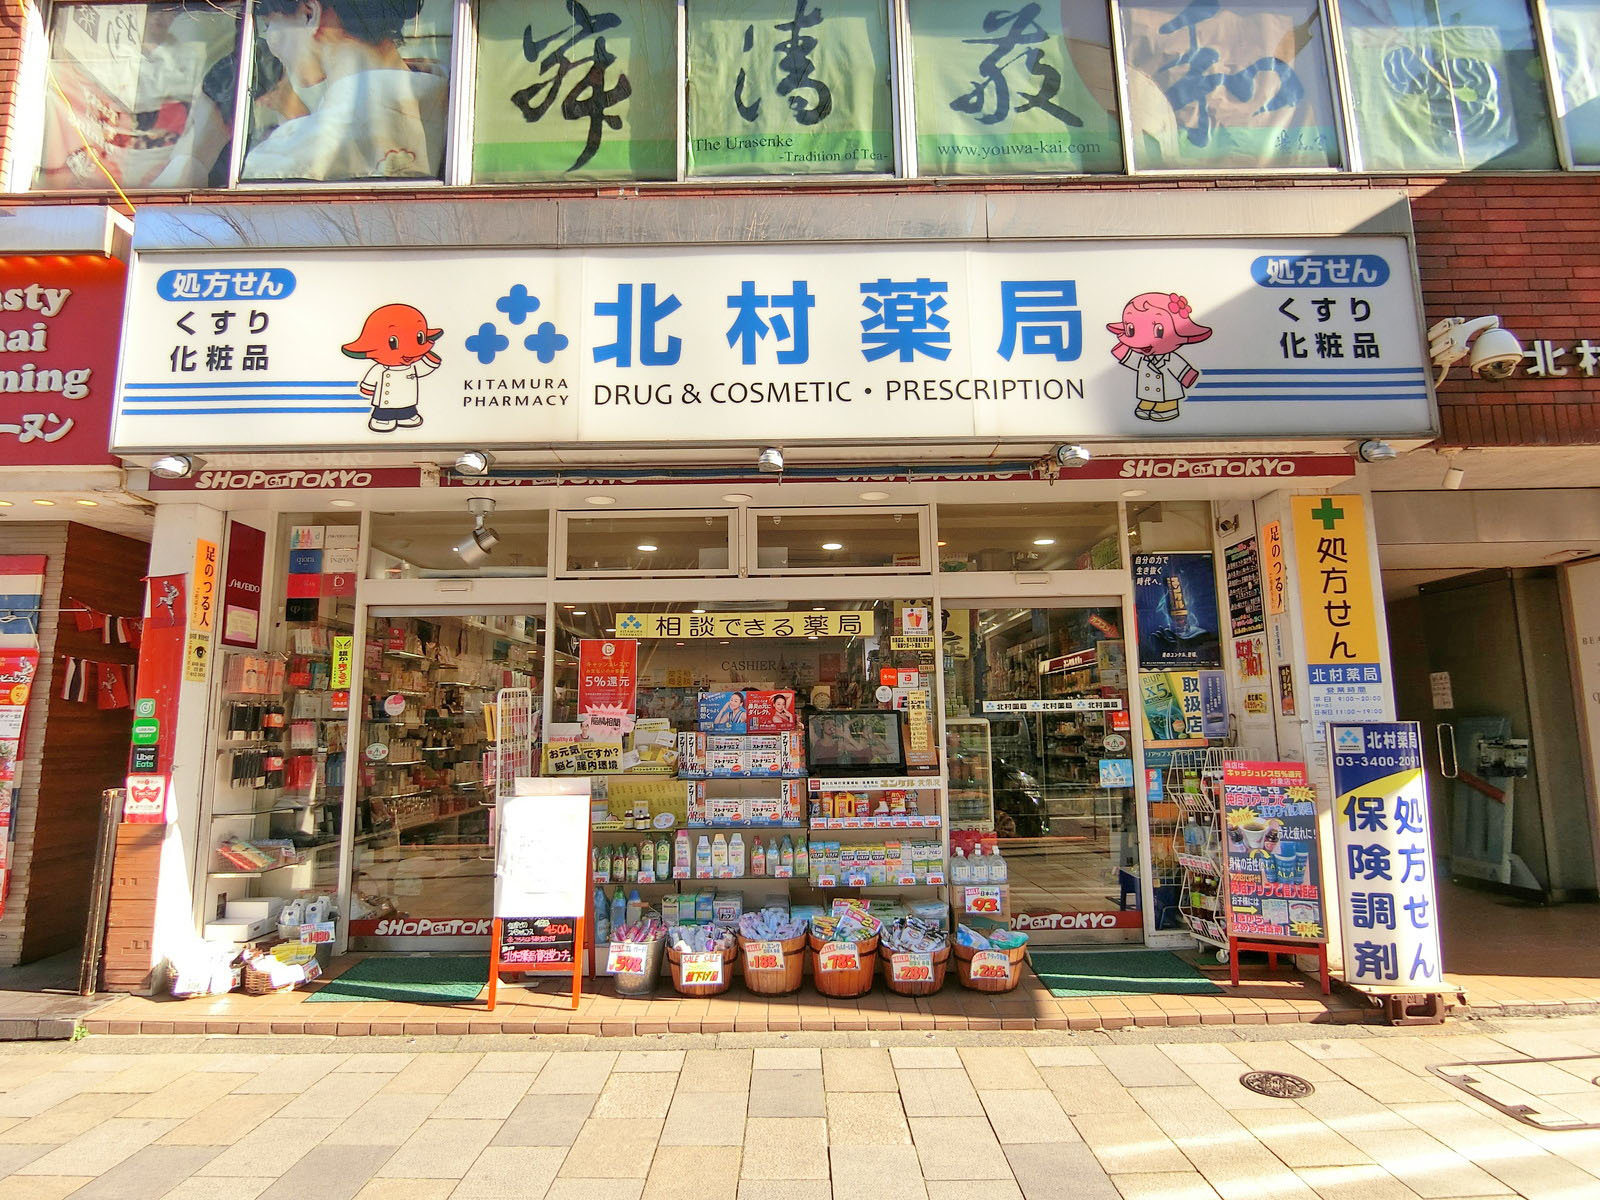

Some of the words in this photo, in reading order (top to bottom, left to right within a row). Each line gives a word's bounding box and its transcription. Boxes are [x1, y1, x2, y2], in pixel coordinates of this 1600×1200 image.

[693, 139, 722, 152] The
[725, 136, 794, 150] Urasenke
[936, 140, 1101, 160] www.youwa-kai.com
[844, 149, 859, 161] of
[1265, 259, 1378, 286] 処方せん
[173, 271, 284, 298] 処方せん
[0, 282, 73, 318] sty
[1278, 297, 1371, 323] くすり
[176, 310, 270, 336] くすり
[592, 278, 1084, 367] 北村薬局
[1280, 331, 1381, 360] 化粧品
[170, 344, 270, 372] 化粧品
[464, 378, 568, 391] KITAMURA
[594, 383, 673, 405] DRUG
[681, 384, 702, 404] &
[710, 381, 853, 404] COSMETIC
[886, 378, 1085, 401] PRESCRIPTION
[463, 394, 570, 407] PHARMACY
[1119, 459, 1191, 478] SHOP
[1212, 458, 1296, 477] TOKYO
[196, 471, 266, 490] SHOP
[288, 470, 373, 488] TOKYO
[1135, 556, 1169, 565] 自分の力で
[200, 545, 217, 628] 足のつる人
[228, 579, 260, 593] SHISEIDO
[1317, 537, 1357, 659] 処方せん
[656, 614, 862, 637] 相談できる薬局
[721, 660, 776, 671] CASHIER
[1312, 667, 1378, 682] 北村薬局
[585, 676, 630, 687] 5%還元
[1182, 677, 1203, 734] 取扱店
[1367, 731, 1418, 750] 北村薬局
[136, 753, 154, 761] Uber
[549, 745, 581, 759] お元気
[1335, 756, 1420, 767] 03-3400-2091
[555, 759, 574, 772] 脳と
[1227, 769, 1303, 778] キャッシュレス5%還元
[1343, 796, 1400, 981] 保険調剤
[1393, 796, 1435, 981] 処方せん
[375, 920, 431, 936] SHOP
[1050, 913, 1117, 929] TOKYO
[682, 955, 699, 964] SALE
[703, 954, 720, 963] SALE
